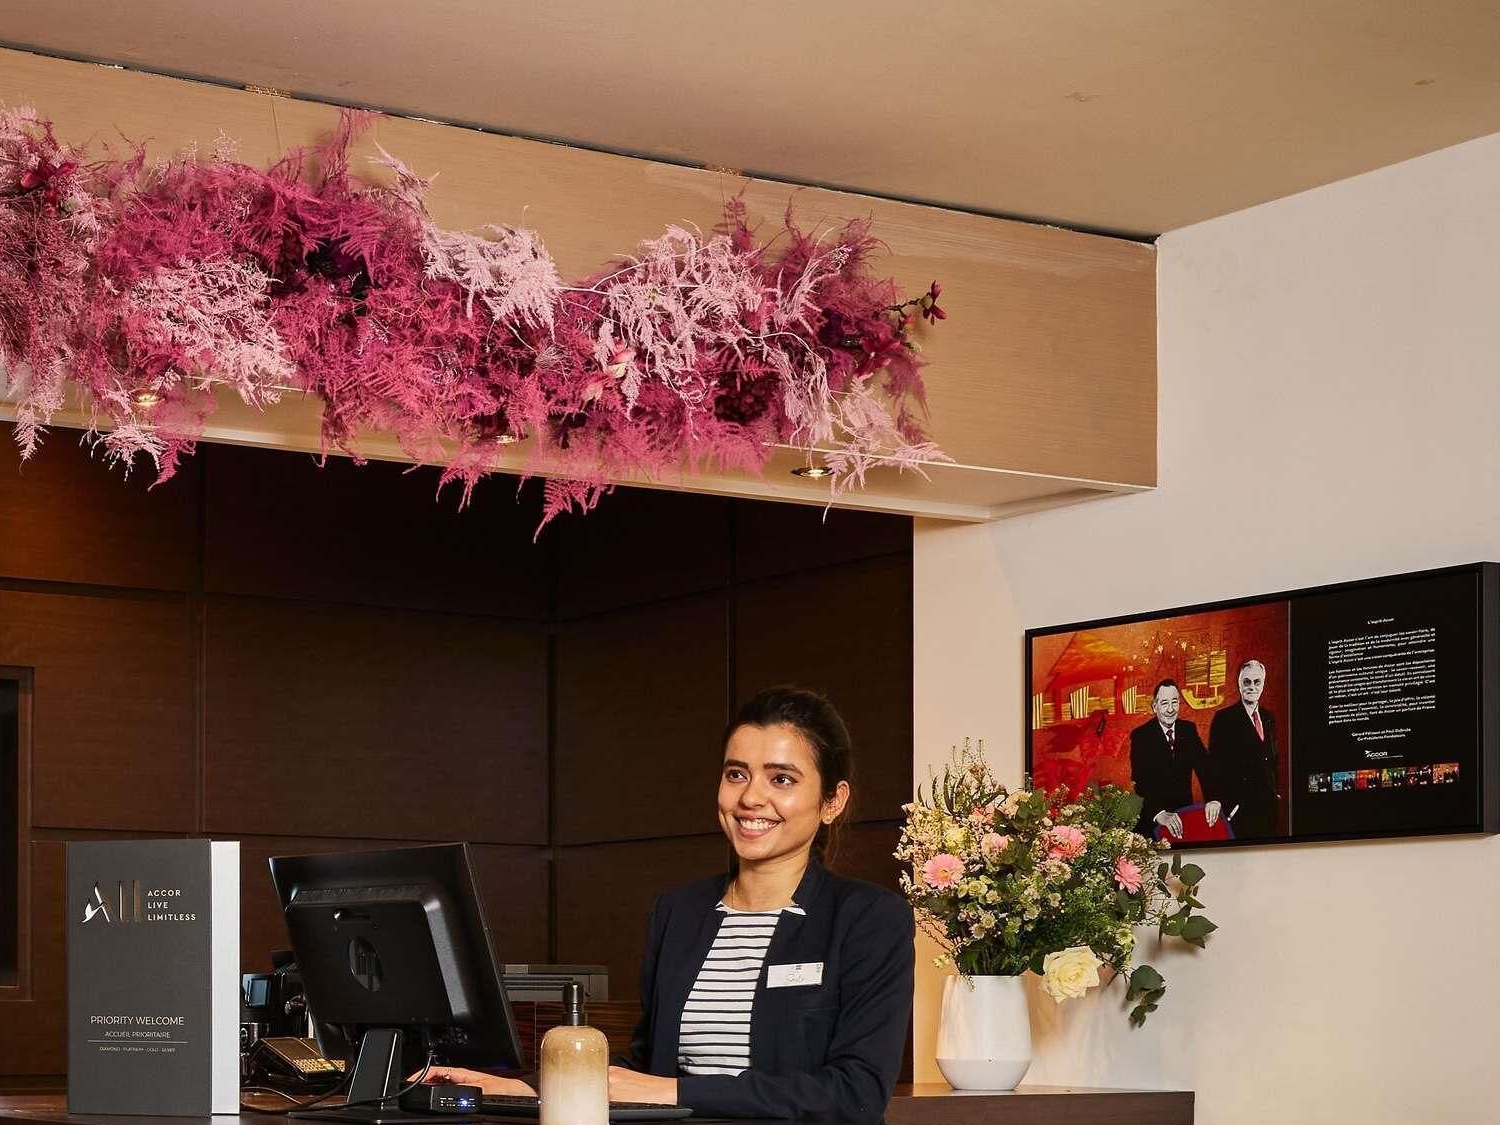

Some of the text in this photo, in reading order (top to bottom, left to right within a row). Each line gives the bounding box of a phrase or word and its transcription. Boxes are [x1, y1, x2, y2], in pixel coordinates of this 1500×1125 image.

[147, 888, 182, 898] ACCOR
[147, 901, 169, 909] LIVE
[147, 913, 197, 922] LIMITLESS
[90, 1015, 185, 1026] PRIORITY WELCOME
